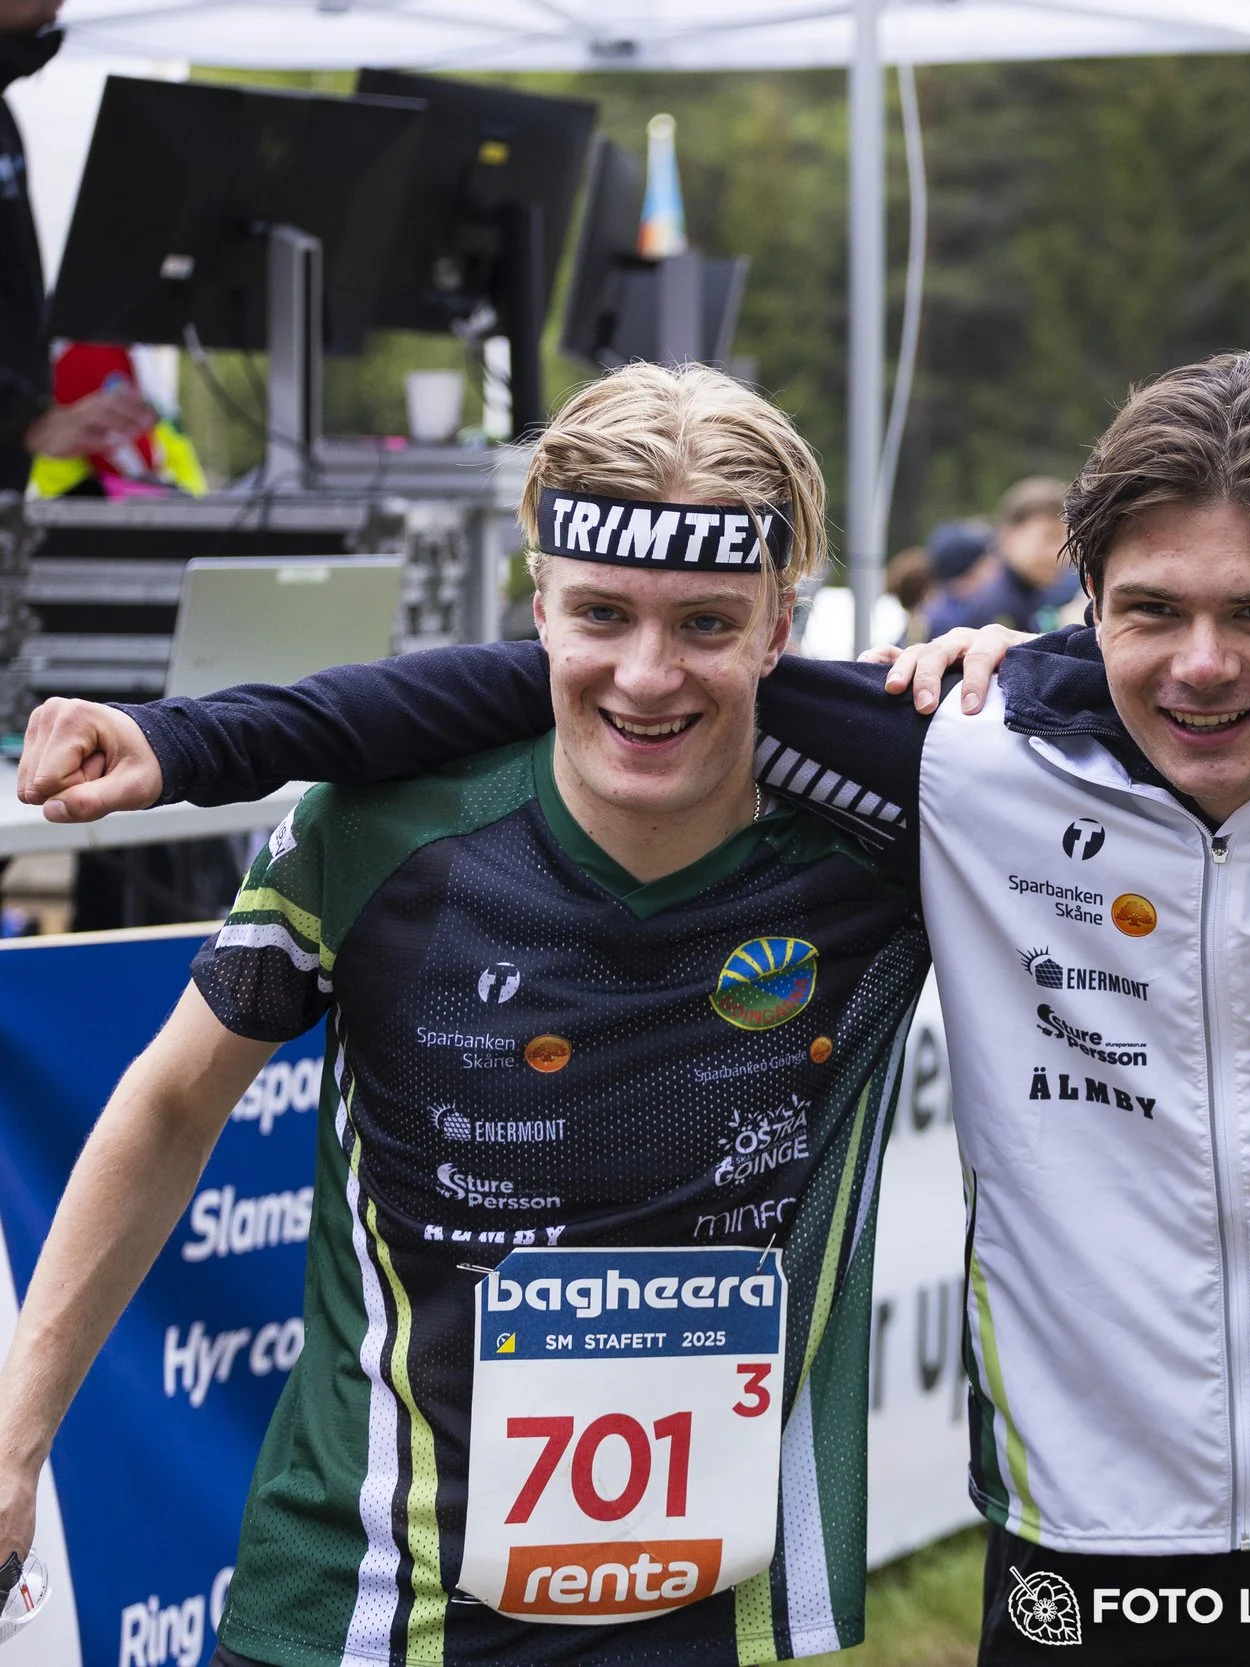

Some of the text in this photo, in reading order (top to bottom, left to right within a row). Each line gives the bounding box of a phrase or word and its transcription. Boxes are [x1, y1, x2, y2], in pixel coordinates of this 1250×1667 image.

[1008, 874, 1104, 906] Sparbanken
[1055, 902, 1104, 926] Skåne
[1066, 967, 1150, 1001] ENERMONT
[416, 1026, 516, 1051] Sparbanken
[1036, 1003, 1103, 1045] Sture
[462, 1052, 516, 1069] Skåne
[694, 1060, 768, 1083] Sparbanken
[1029, 1066, 1157, 1121] ÄLMBY
[474, 1119, 567, 1142] ENERMONT
[437, 1162, 514, 1200] Sture
[487, 1269, 776, 1319] bagheera
[545, 1330, 727, 1350] SM STAFETT 2025
[163, 1320, 252, 1410] Hyr
[731, 1362, 772, 1418] 3
[503, 1410, 693, 1525] 701
[522, 1552, 700, 1604] renta
[118, 1593, 206, 1667] Ring
